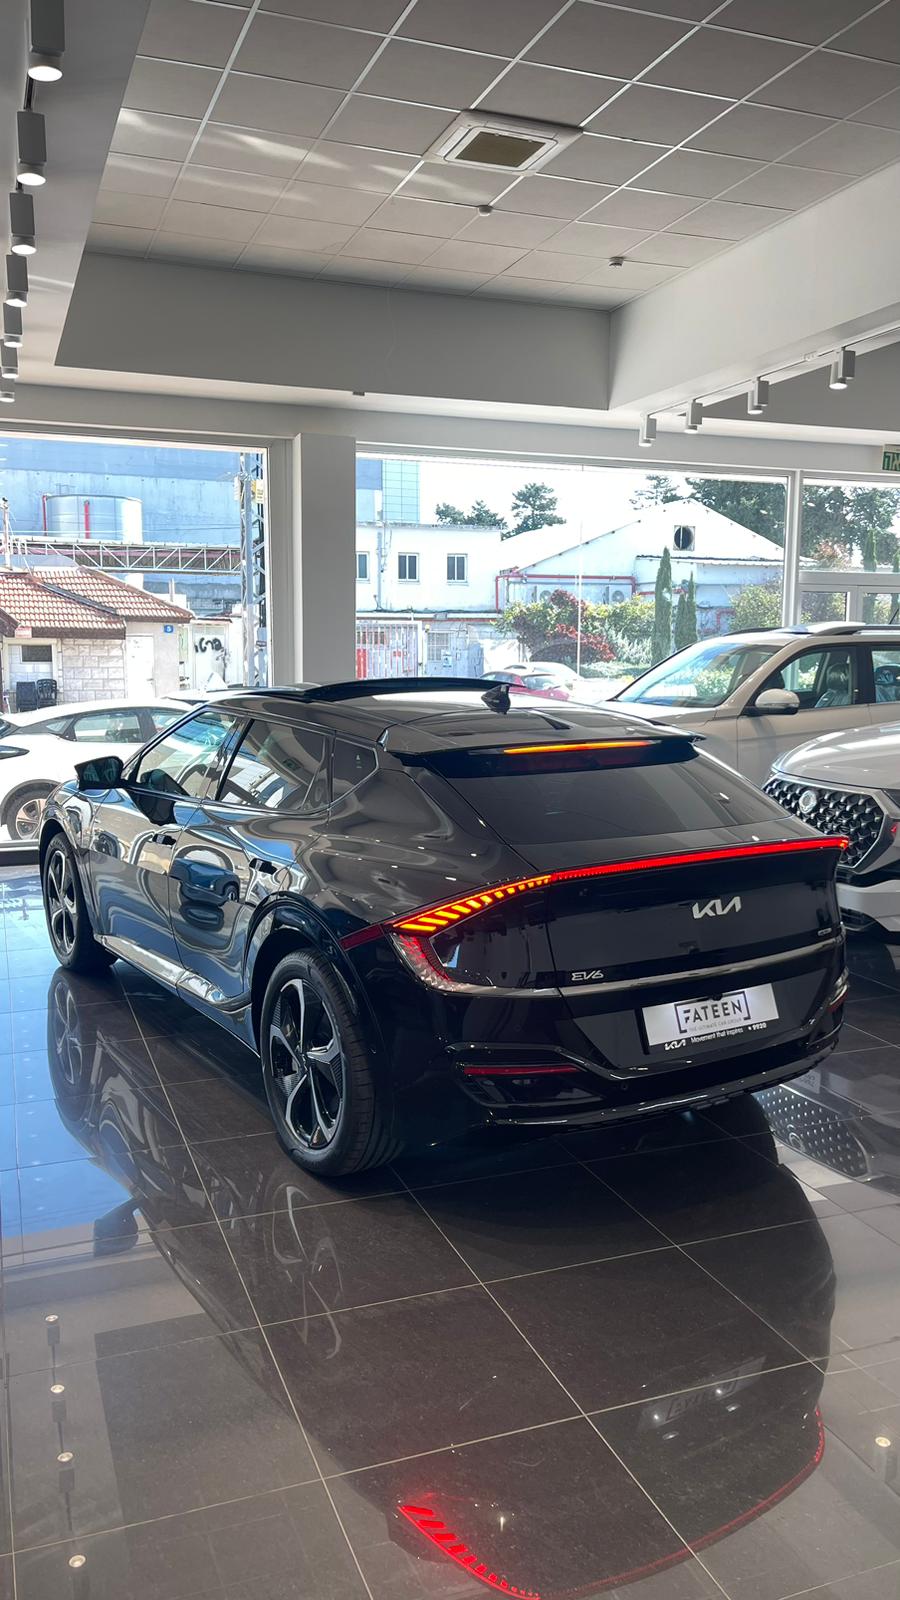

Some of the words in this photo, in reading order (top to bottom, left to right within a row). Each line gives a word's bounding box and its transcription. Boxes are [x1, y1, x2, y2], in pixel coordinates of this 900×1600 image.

[692, 896, 742, 919] KIA
[571, 969, 604, 981] EV6
[683, 999, 743, 1024] FATEEN
[664, 1039, 687, 1051] KIA
[690, 1033, 716, 1044] Movement
[716, 1030, 727, 1038] that
[727, 1027, 744, 1037] inspires
